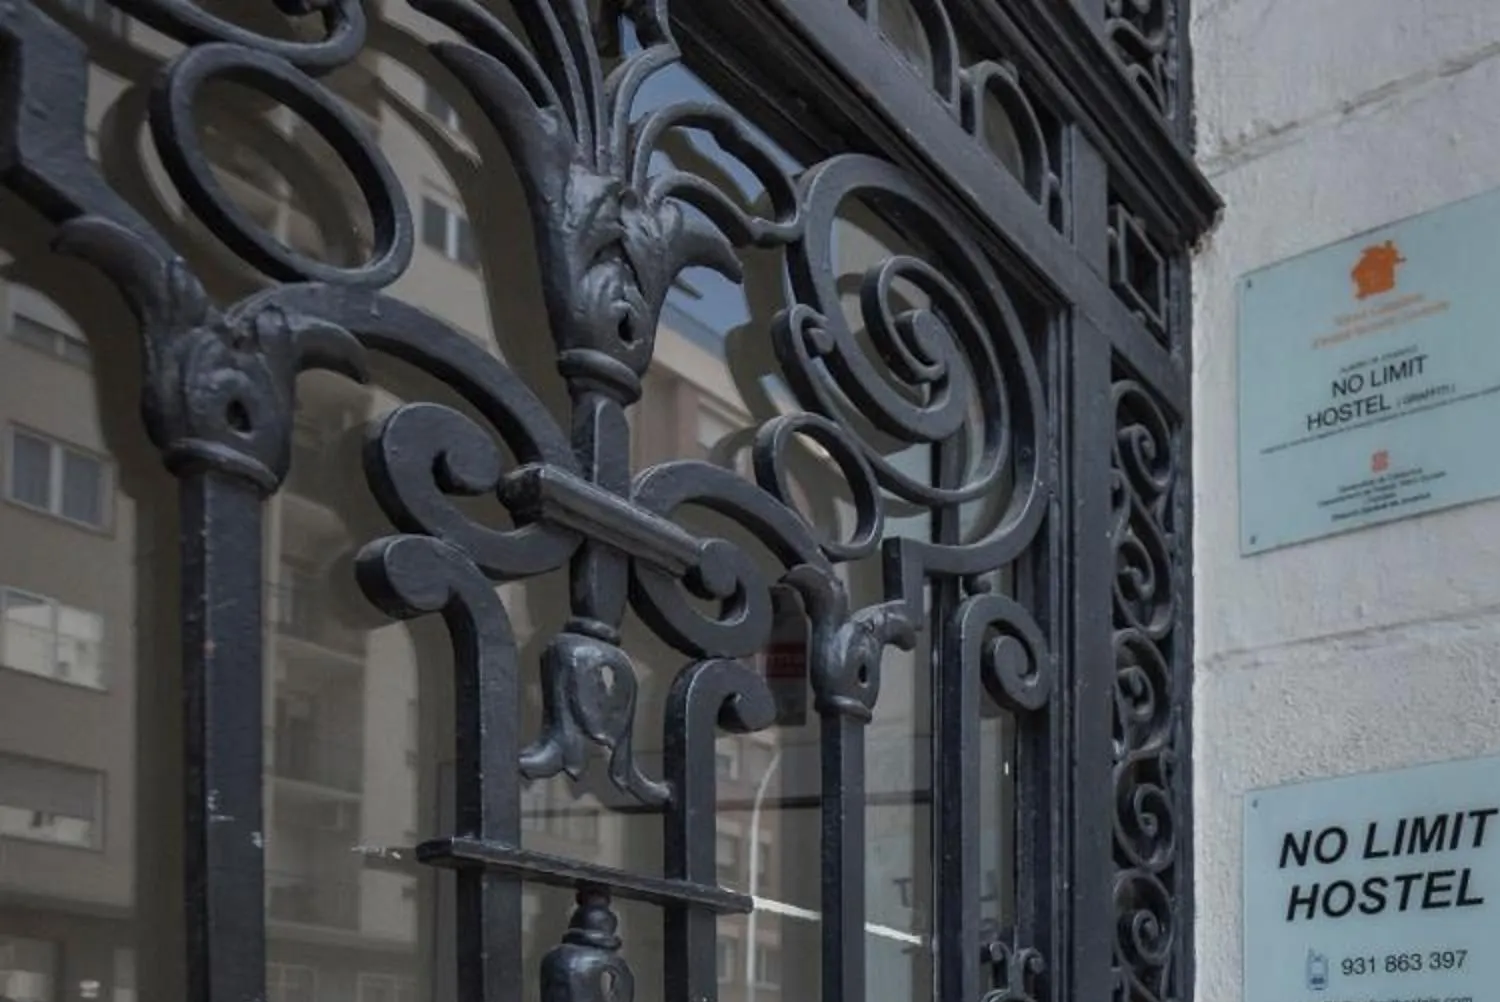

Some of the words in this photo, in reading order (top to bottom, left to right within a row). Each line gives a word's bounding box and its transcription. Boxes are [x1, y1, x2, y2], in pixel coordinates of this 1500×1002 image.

[1332, 373, 1365, 398] NO
[1370, 354, 1429, 387] LIMIT
[1306, 394, 1392, 431] HOSTEL
[1278, 826, 1348, 869] NO
[1362, 808, 1499, 859] LIMIT
[1286, 868, 1484, 923] HOSTEL
[1341, 956, 1376, 976] 931
[1384, 953, 1422, 974] 863
[1429, 950, 1468, 970] 397
